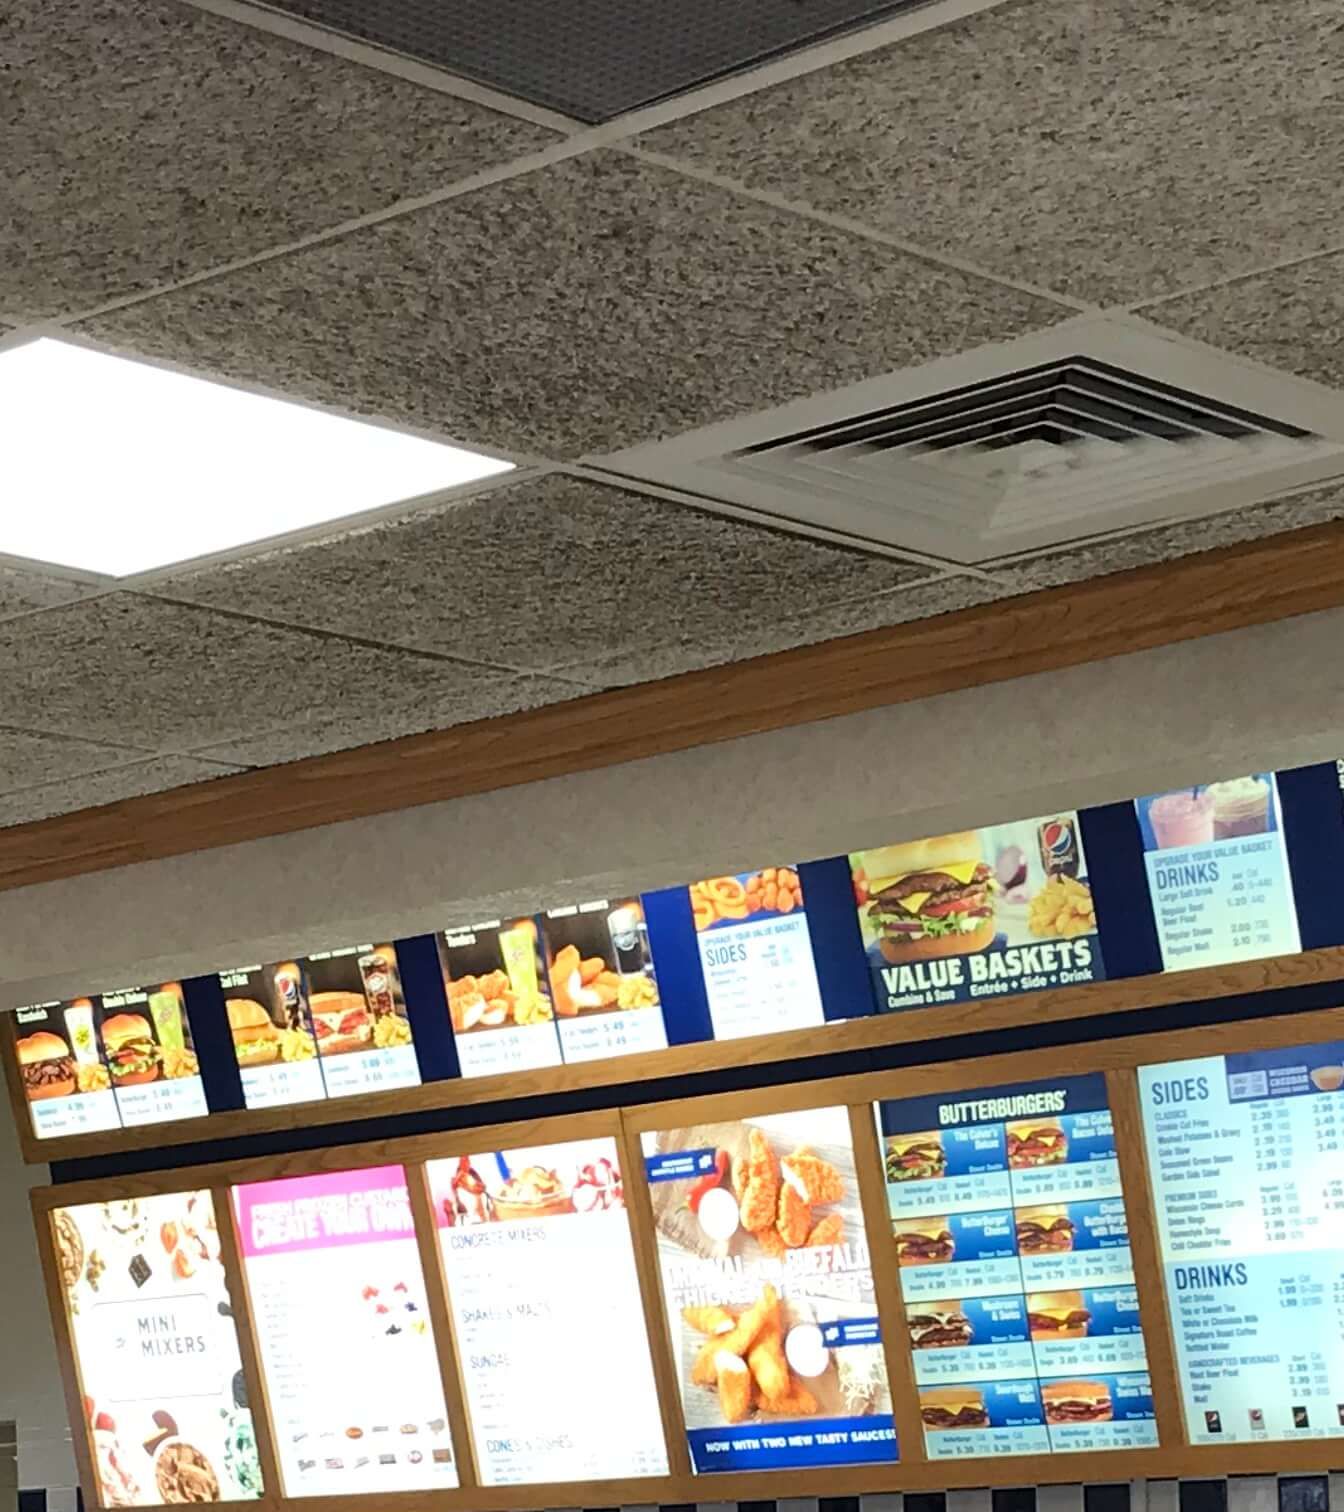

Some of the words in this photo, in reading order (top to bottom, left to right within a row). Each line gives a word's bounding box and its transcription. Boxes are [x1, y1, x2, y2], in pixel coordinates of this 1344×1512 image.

[1214, 845, 1239, 858] VALUE
[1241, 840, 1273, 853] BASKET
[1156, 862, 1220, 889] DRINKS
[706, 943, 747, 967] SIDES
[881, 958, 964, 994] VALUE
[968, 939, 1092, 982] BASKETS
[970, 982, 1008, 997] Entrée
[1020, 976, 1047, 989] Side
[1060, 969, 1093, 983] Drink
[888, 994, 924, 1008] Combine
[1151, 1077, 1209, 1106] SIDES
[253, 1214, 320, 1249] CREATE
[323, 1208, 368, 1237] YOUR
[1174, 1262, 1248, 1290] DRINKS
[137, 1314, 176, 1334] MINI
[141, 1336, 206, 1356] MIXERS
[706, 1441, 731, 1454] NOW
[732, 1438, 760, 1452] WITH
[761, 1437, 787, 1449] TWO
[788, 1435, 813, 1447] NEW
[815, 1432, 849, 1446] TASTY
[851, 1428, 896, 1443] SAUCES!
